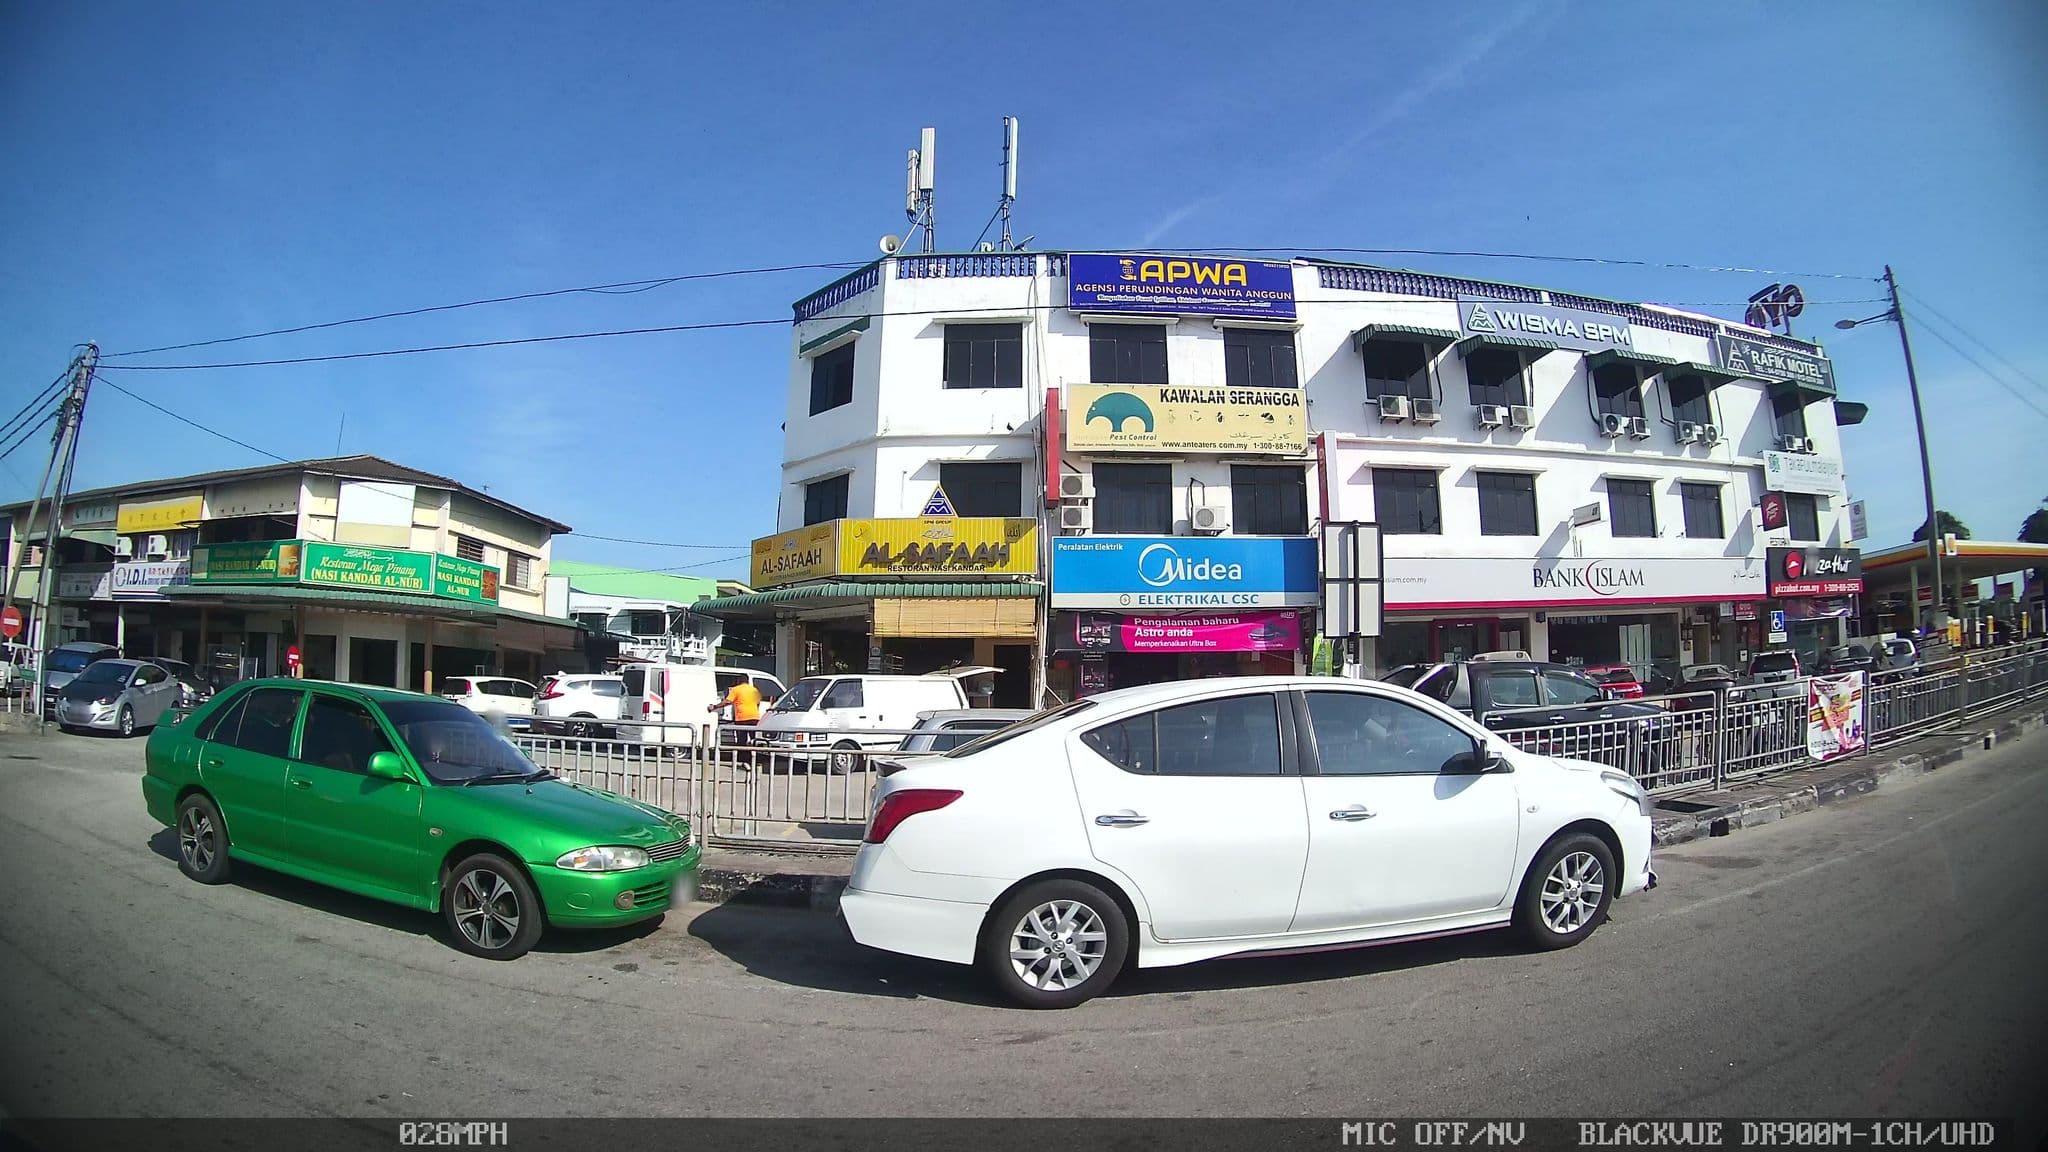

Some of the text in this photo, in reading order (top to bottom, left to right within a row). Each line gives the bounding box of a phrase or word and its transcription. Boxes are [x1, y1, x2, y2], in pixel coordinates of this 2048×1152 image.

[1140, 260, 1247, 286] APWA
[1076, 283, 1292, 300] AGENSI PERUNDINGAN WANITA ANGGUN
[1496, 309, 1631, 345] WISMA SPM
[1751, 350, 1787, 370] RAFIK
[1787, 358, 1823, 378] MOTEL
[1160, 388, 1300, 406] KAWALAN SERANGGA
[1161, 441, 1248, 450] www.anteaters.com.my
[861, 542, 1010, 568] AL-SAFAAH
[1058, 543, 1124, 551] Peralatan Elektrik
[320, 556, 417, 577] Restoran Mega Pinang
[761, 547, 822, 575] AL-SAFAAH
[1153, 557, 1242, 581] Midea
[311, 568, 423, 590] (NASI KANDAR AL-NUR)
[437, 572, 480, 587] NASI KANDAR
[1533, 568, 1645, 588] BANK ISLAM
[1138, 594, 1259, 605] ELEKTRIKAL CSC
[1134, 617, 1239, 627] Pengalaman baharu
[1135, 628, 1193, 637] Astro anda
[1134, 640, 1188, 648] Memperkenalkan
